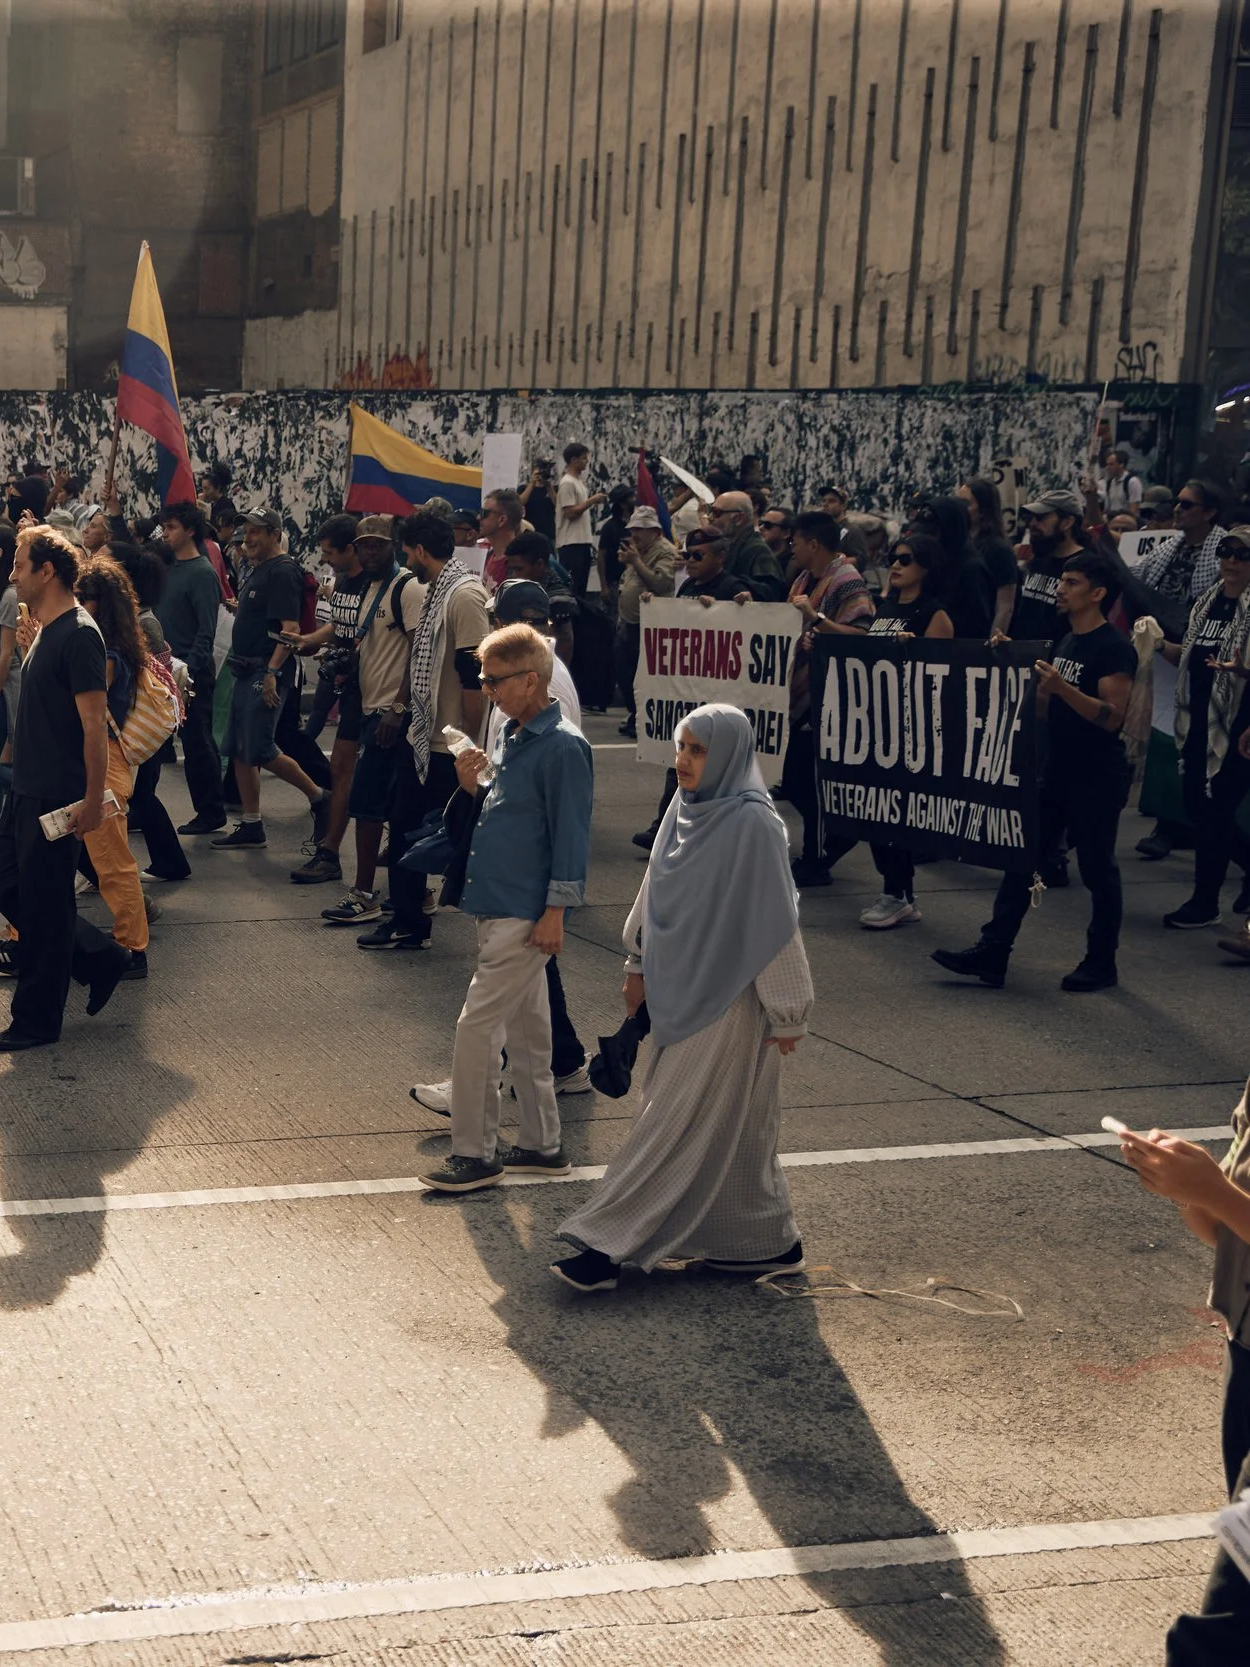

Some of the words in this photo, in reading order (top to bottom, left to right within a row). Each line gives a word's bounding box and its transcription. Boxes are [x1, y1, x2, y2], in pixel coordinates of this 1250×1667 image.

[644, 627, 743, 681] VETERANS
[748, 634, 792, 687] SAY
[819, 656, 950, 777] ABOUT
[962, 666, 1032, 788] FACE
[821, 779, 902, 824] VETERANS
[906, 792, 965, 836] AGAINST
[964, 802, 986, 842] THE
[986, 807, 1025, 848] WAR
